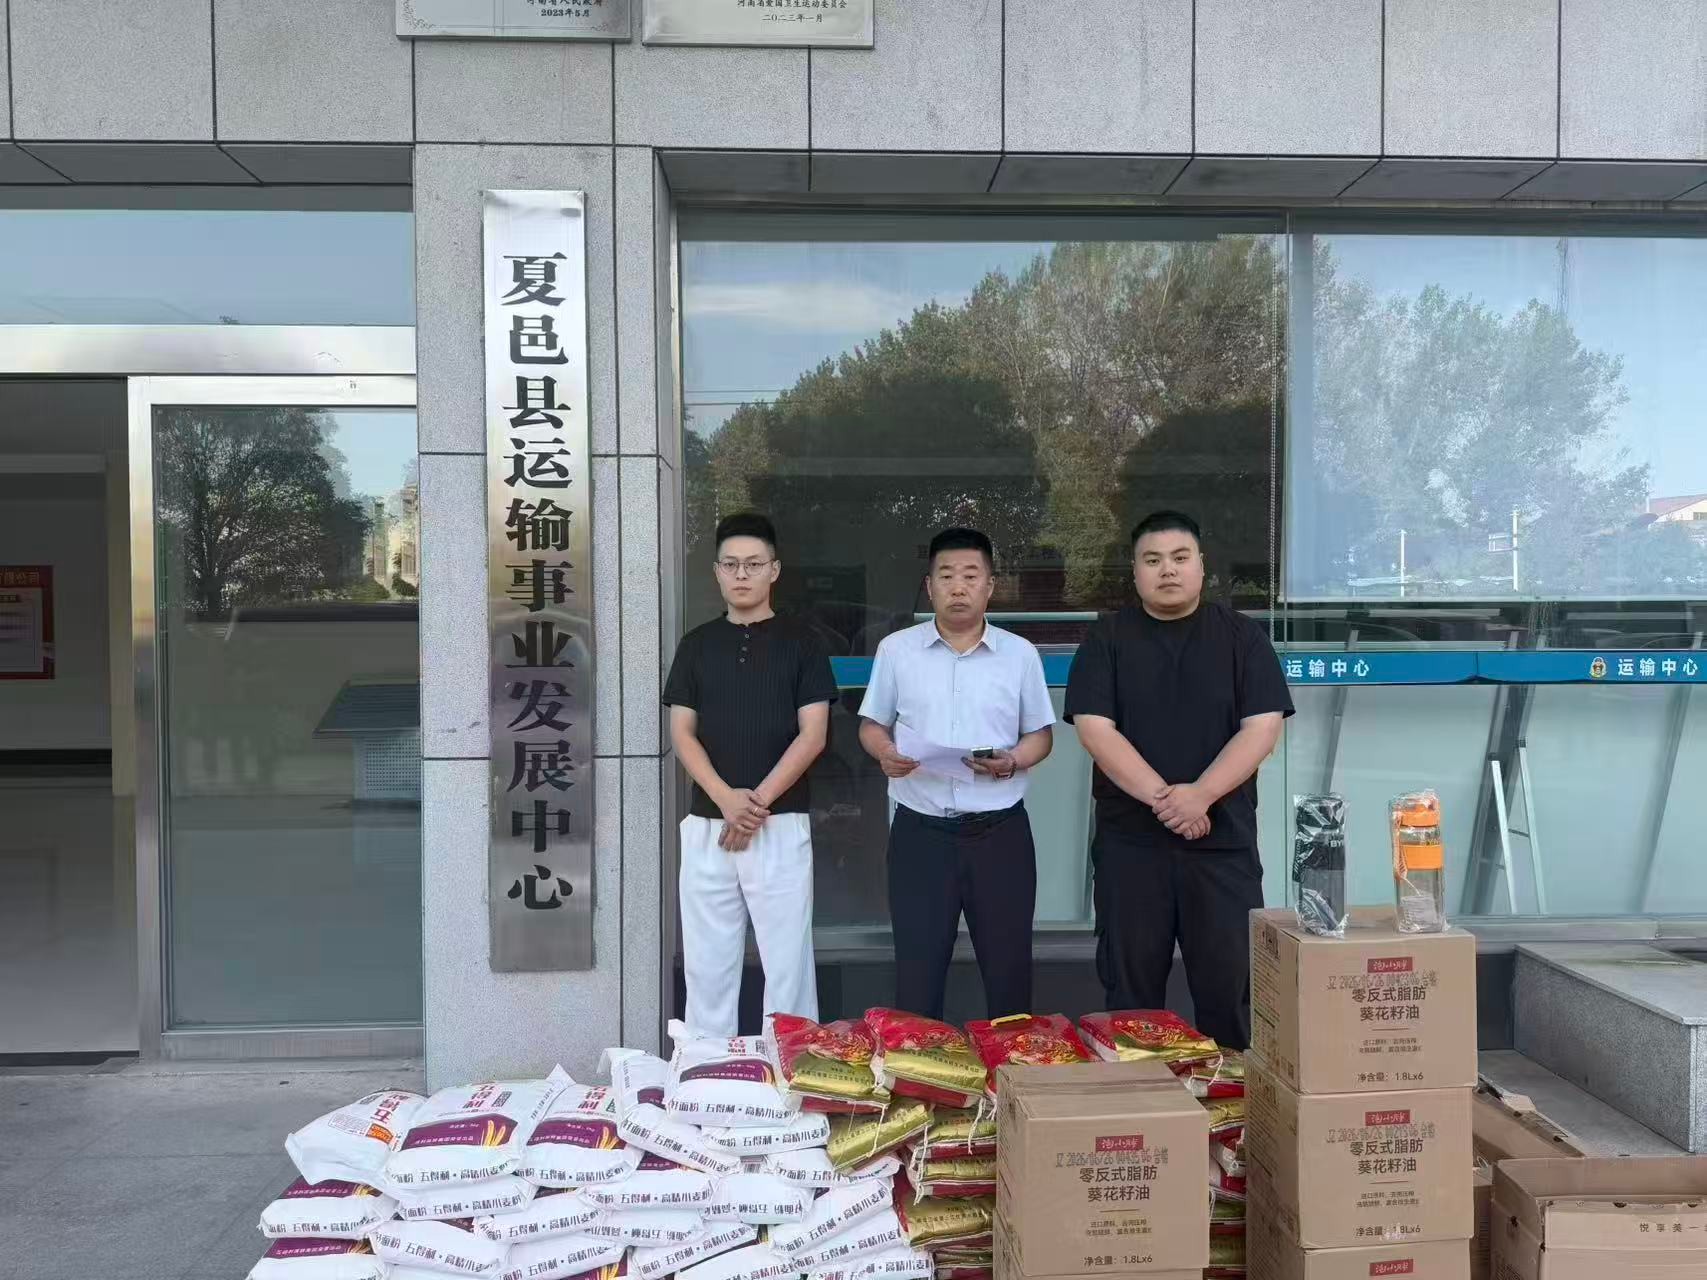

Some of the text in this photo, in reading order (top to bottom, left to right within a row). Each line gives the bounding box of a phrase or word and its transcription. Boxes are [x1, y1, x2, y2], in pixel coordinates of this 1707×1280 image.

[501, 251, 573, 910] 夏邑县运输事业发展中心
[1286, 658, 1370, 678] 运输中心
[1617, 658, 1699, 677] 运输中心
[1351, 985, 1427, 1003] 零反式脂肪
[1360, 1004, 1420, 1022] 葵花籽油
[710, 1136, 736, 1148] 面粉
[1350, 1137, 1424, 1157] 零反式脂肪
[1079, 1164, 1158, 1184] 零反式脂肪
[1358, 1157, 1417, 1175] 葵花籽油
[588, 1193, 614, 1204] 面粉
[1088, 1184, 1150, 1203] 葵花籽油
